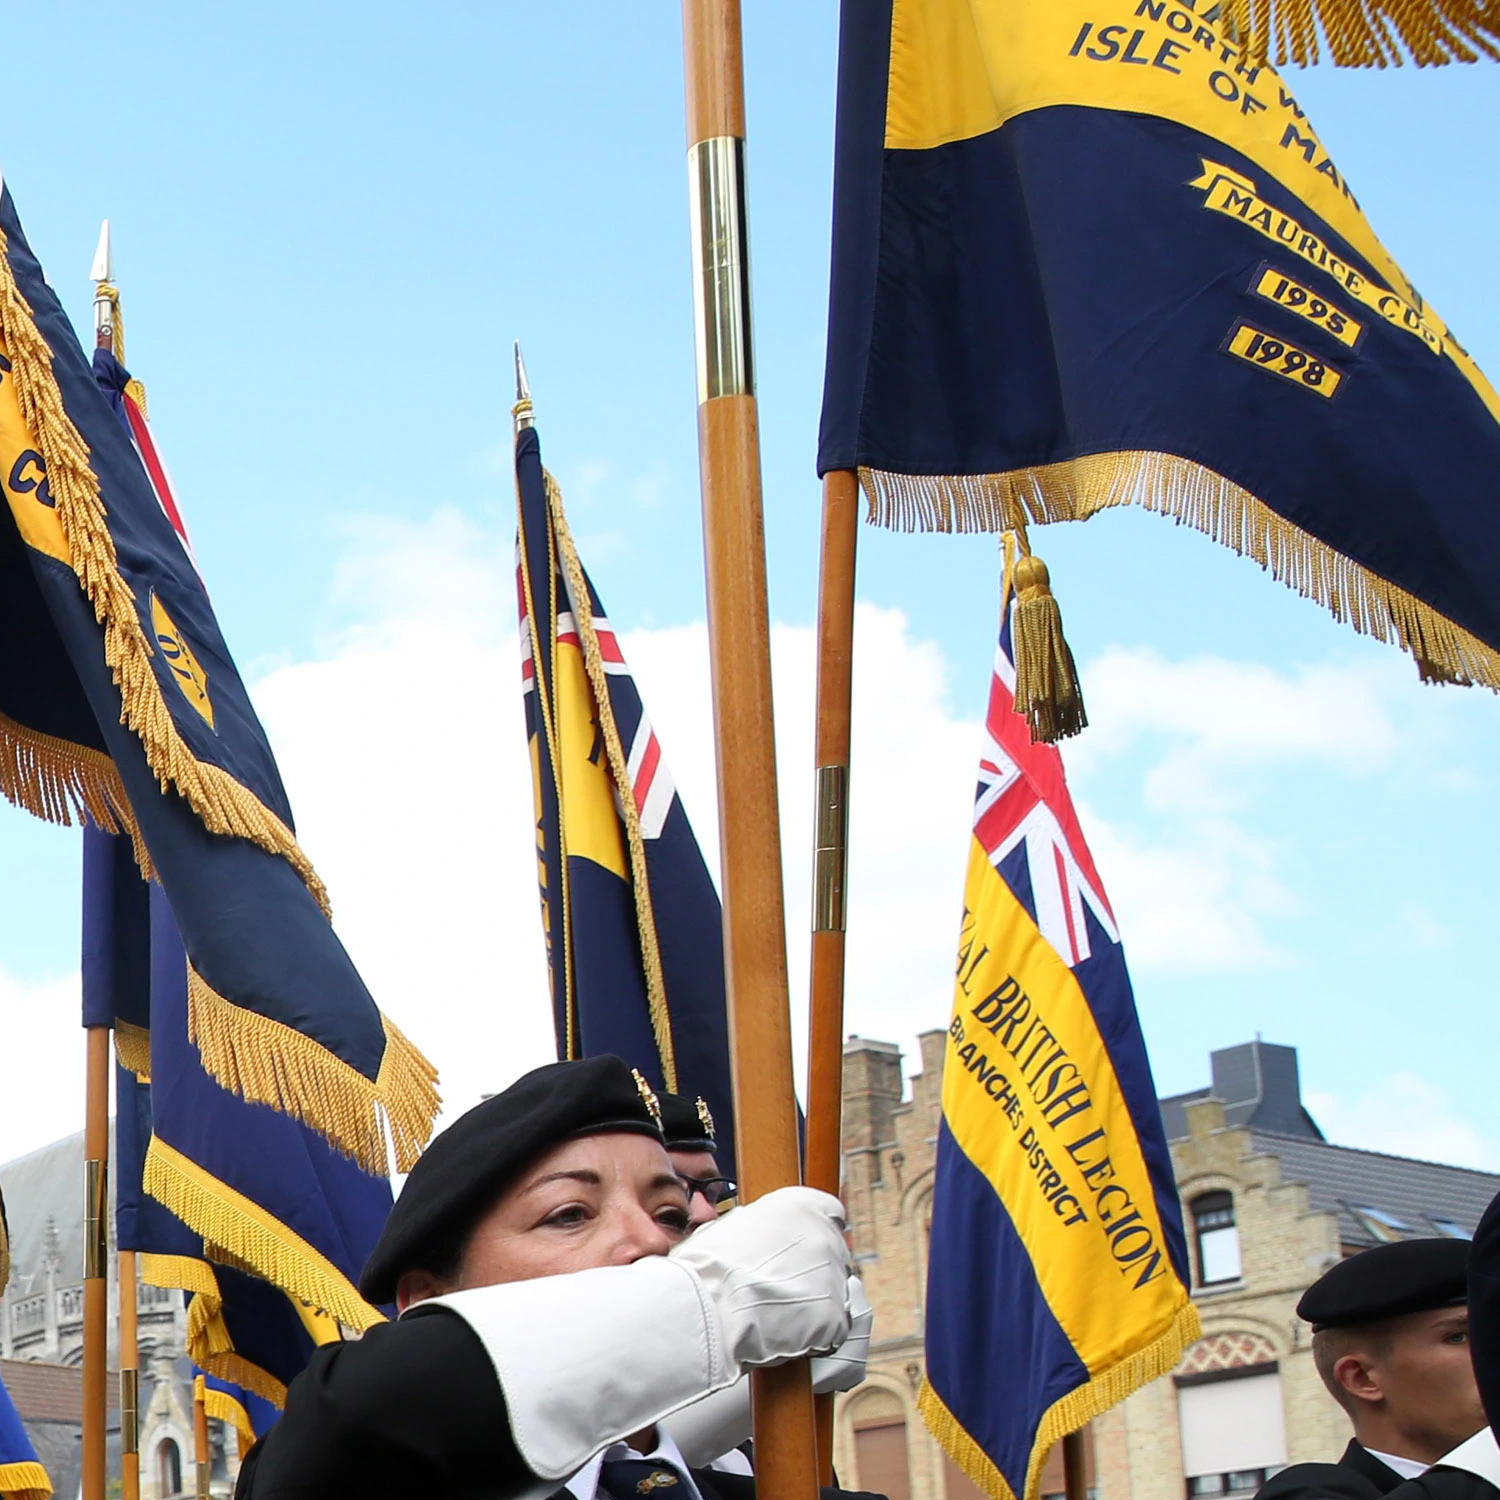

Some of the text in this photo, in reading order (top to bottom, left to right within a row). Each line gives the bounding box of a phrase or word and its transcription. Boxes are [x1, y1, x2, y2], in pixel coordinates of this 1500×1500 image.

[1068, 22, 1191, 75] ISLE
[1208, 70, 1267, 116] OF
[1222, 187, 1365, 296] MAURICE
[1273, 278, 1347, 335] 1995
[1244, 334, 1325, 387] 1998
[949, 1013, 1088, 1228] BRANCHES DISTRICT
[972, 973, 1093, 1131] BRITISH
[1064, 1125, 1167, 1292] LEGION
